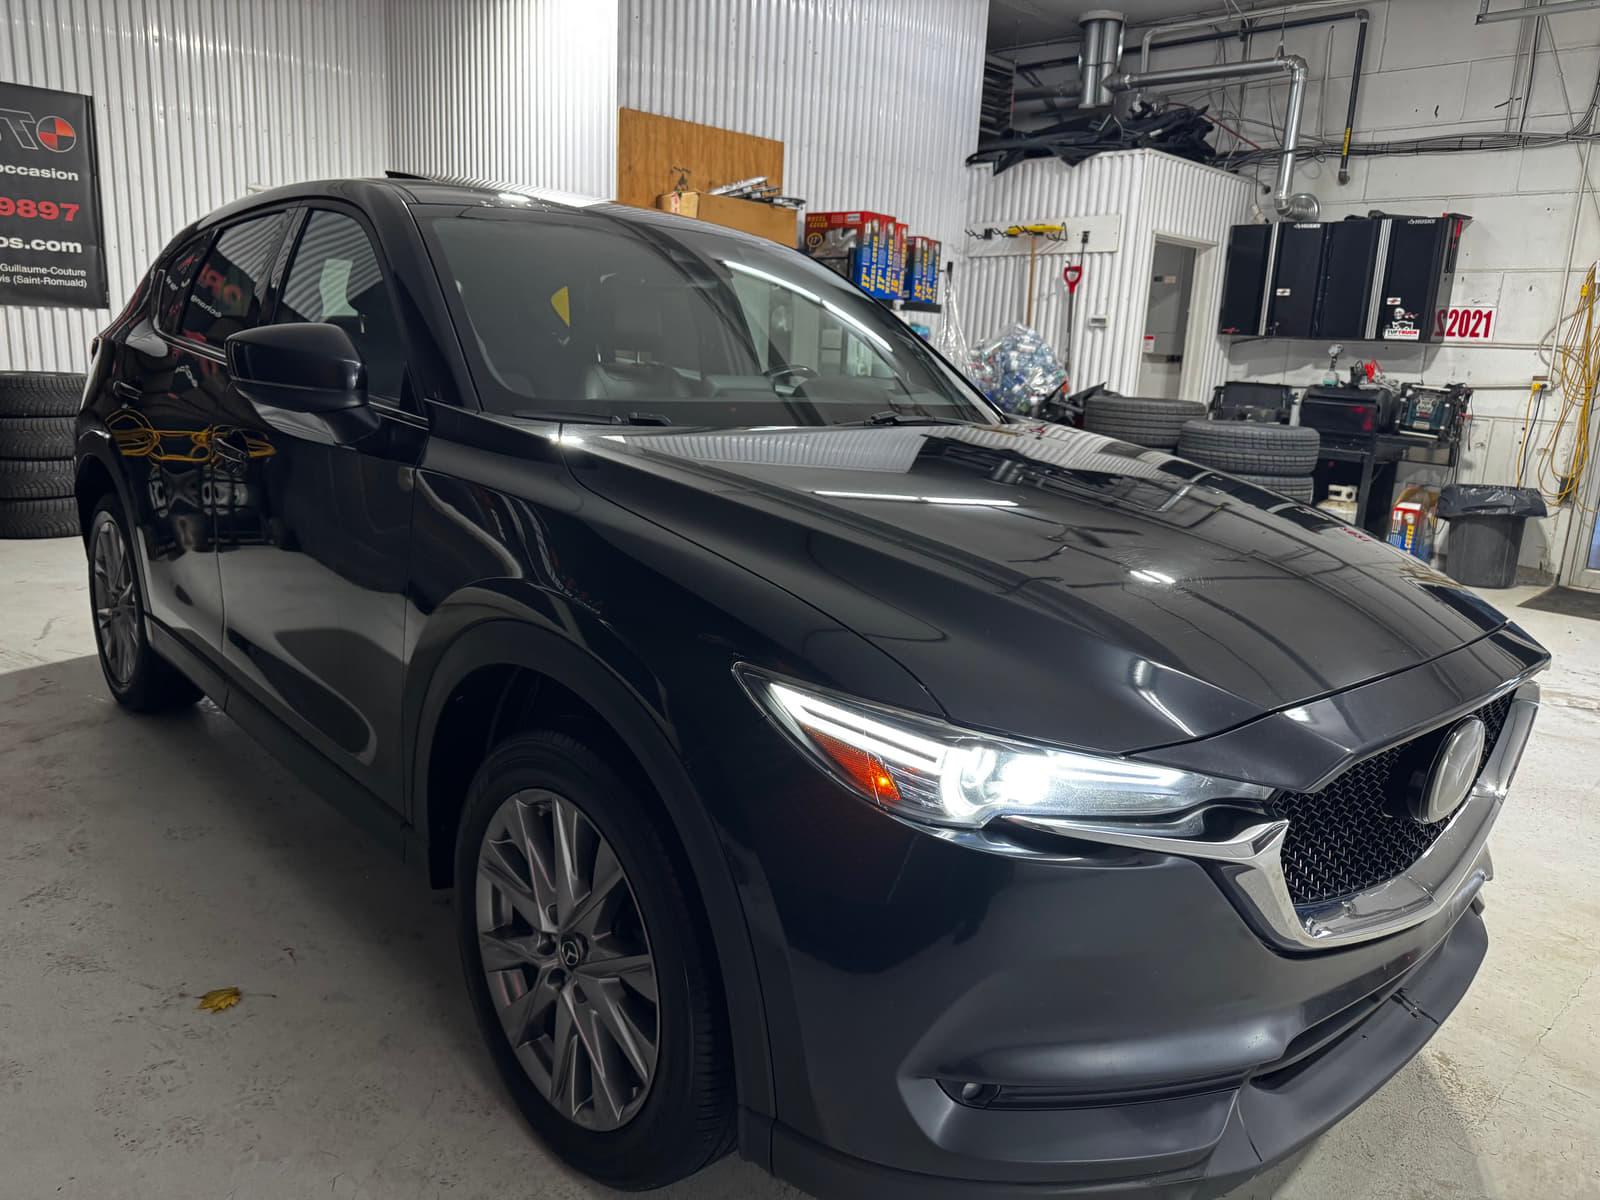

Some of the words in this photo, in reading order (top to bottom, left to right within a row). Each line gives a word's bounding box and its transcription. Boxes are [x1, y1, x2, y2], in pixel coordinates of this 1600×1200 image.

[0, 196, 80, 222] 9897
[0, 236, 83, 253] os.com
[0, 263, 87, 277] Guillaume-Couture
[13, 275, 88, 289] (Saint-Romuald)
[1445, 308, 1493, 338] 2021
